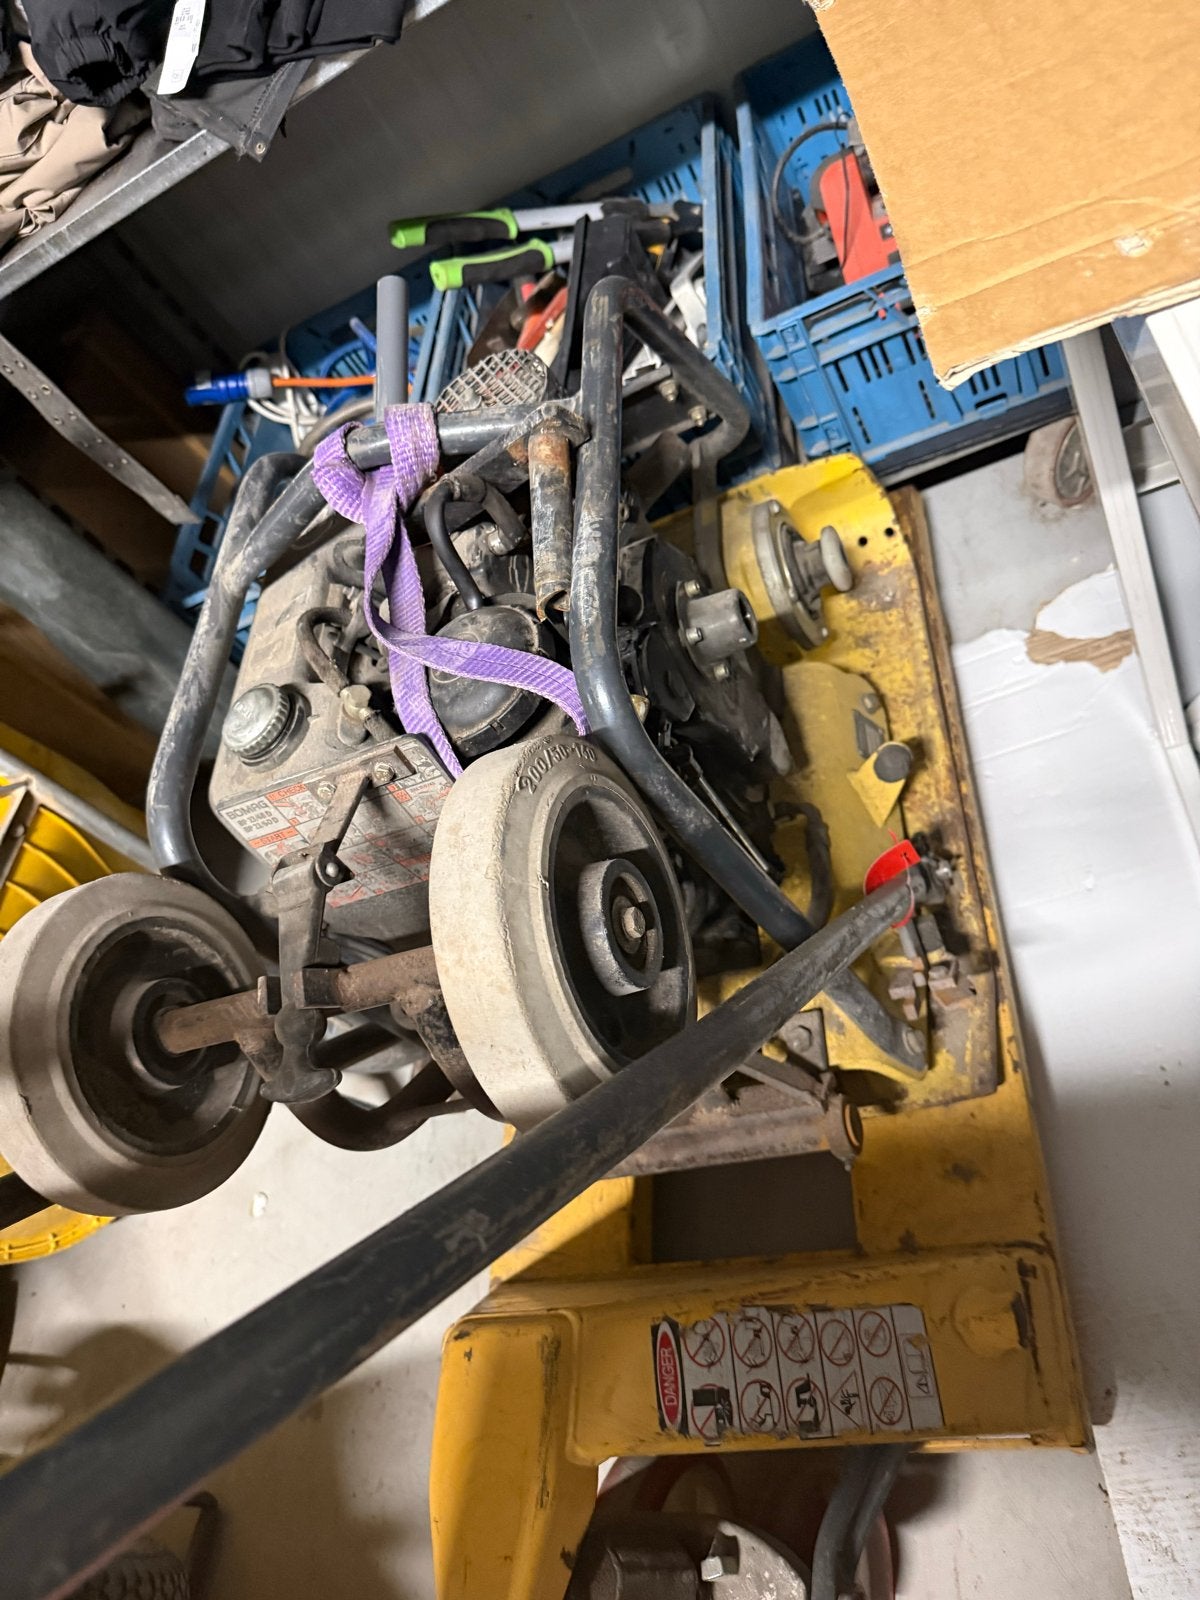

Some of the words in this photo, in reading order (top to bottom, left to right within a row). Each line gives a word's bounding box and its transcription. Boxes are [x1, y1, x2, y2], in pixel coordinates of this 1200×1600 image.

[277, 783, 306, 797] CHECK
[226, 800, 269, 820] BOMAG
[260, 831, 286, 845] START
[660, 1347, 678, 1406] DANGER
